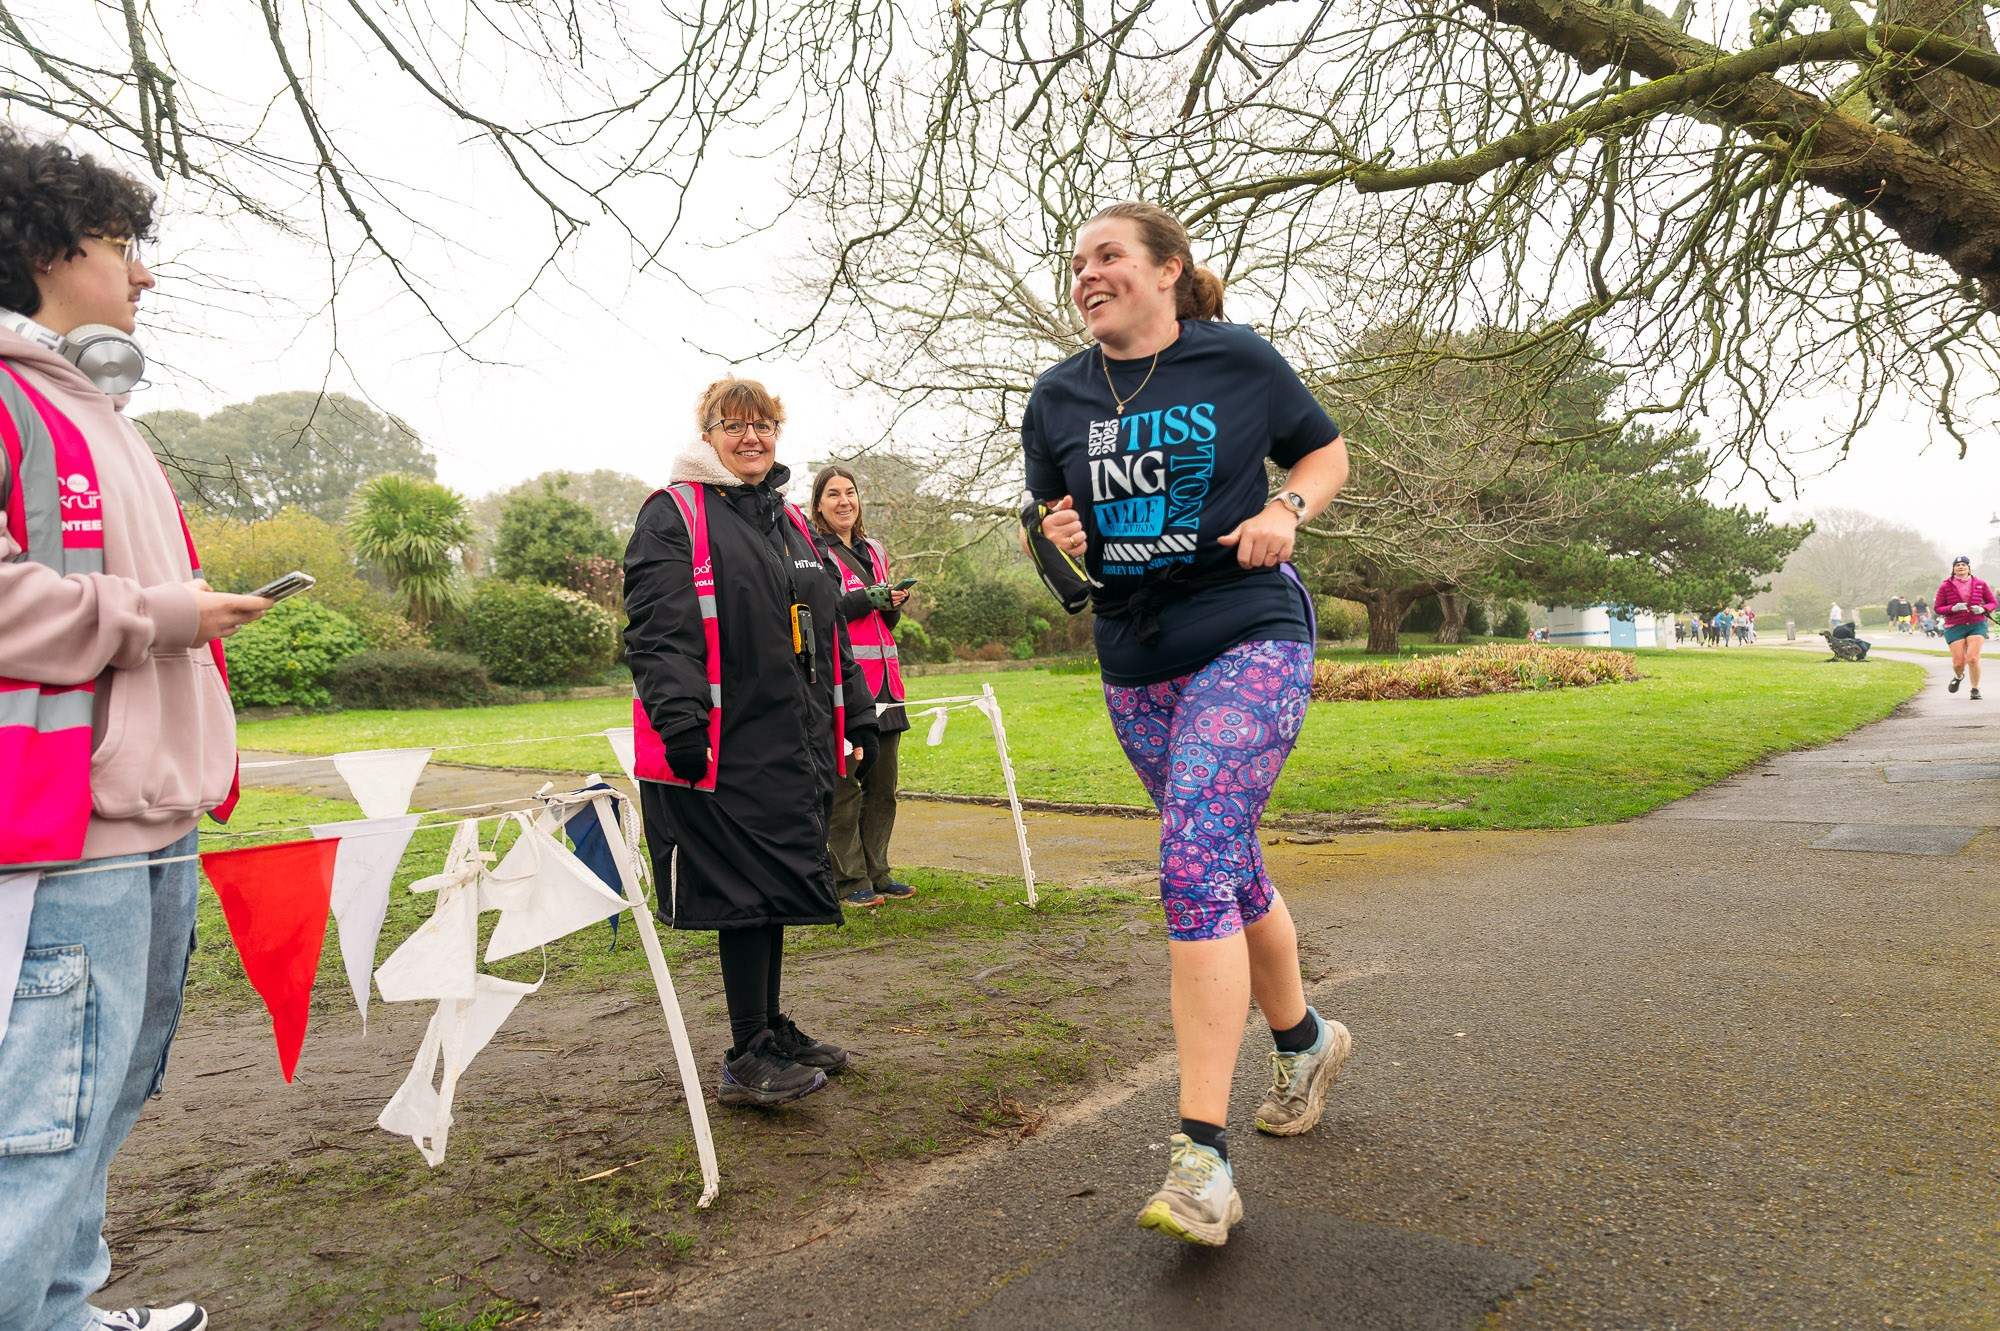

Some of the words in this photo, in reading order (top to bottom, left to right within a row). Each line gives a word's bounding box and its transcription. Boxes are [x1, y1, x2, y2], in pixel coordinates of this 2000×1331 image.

[1087, 420, 1104, 457] SEPT
[1101, 418, 1120, 454] 2025
[1120, 403, 1217, 451] TISS
[1088, 450, 1166, 502] ING
[1168, 443, 1216, 530] TON
[1101, 500, 1159, 526] HALF
